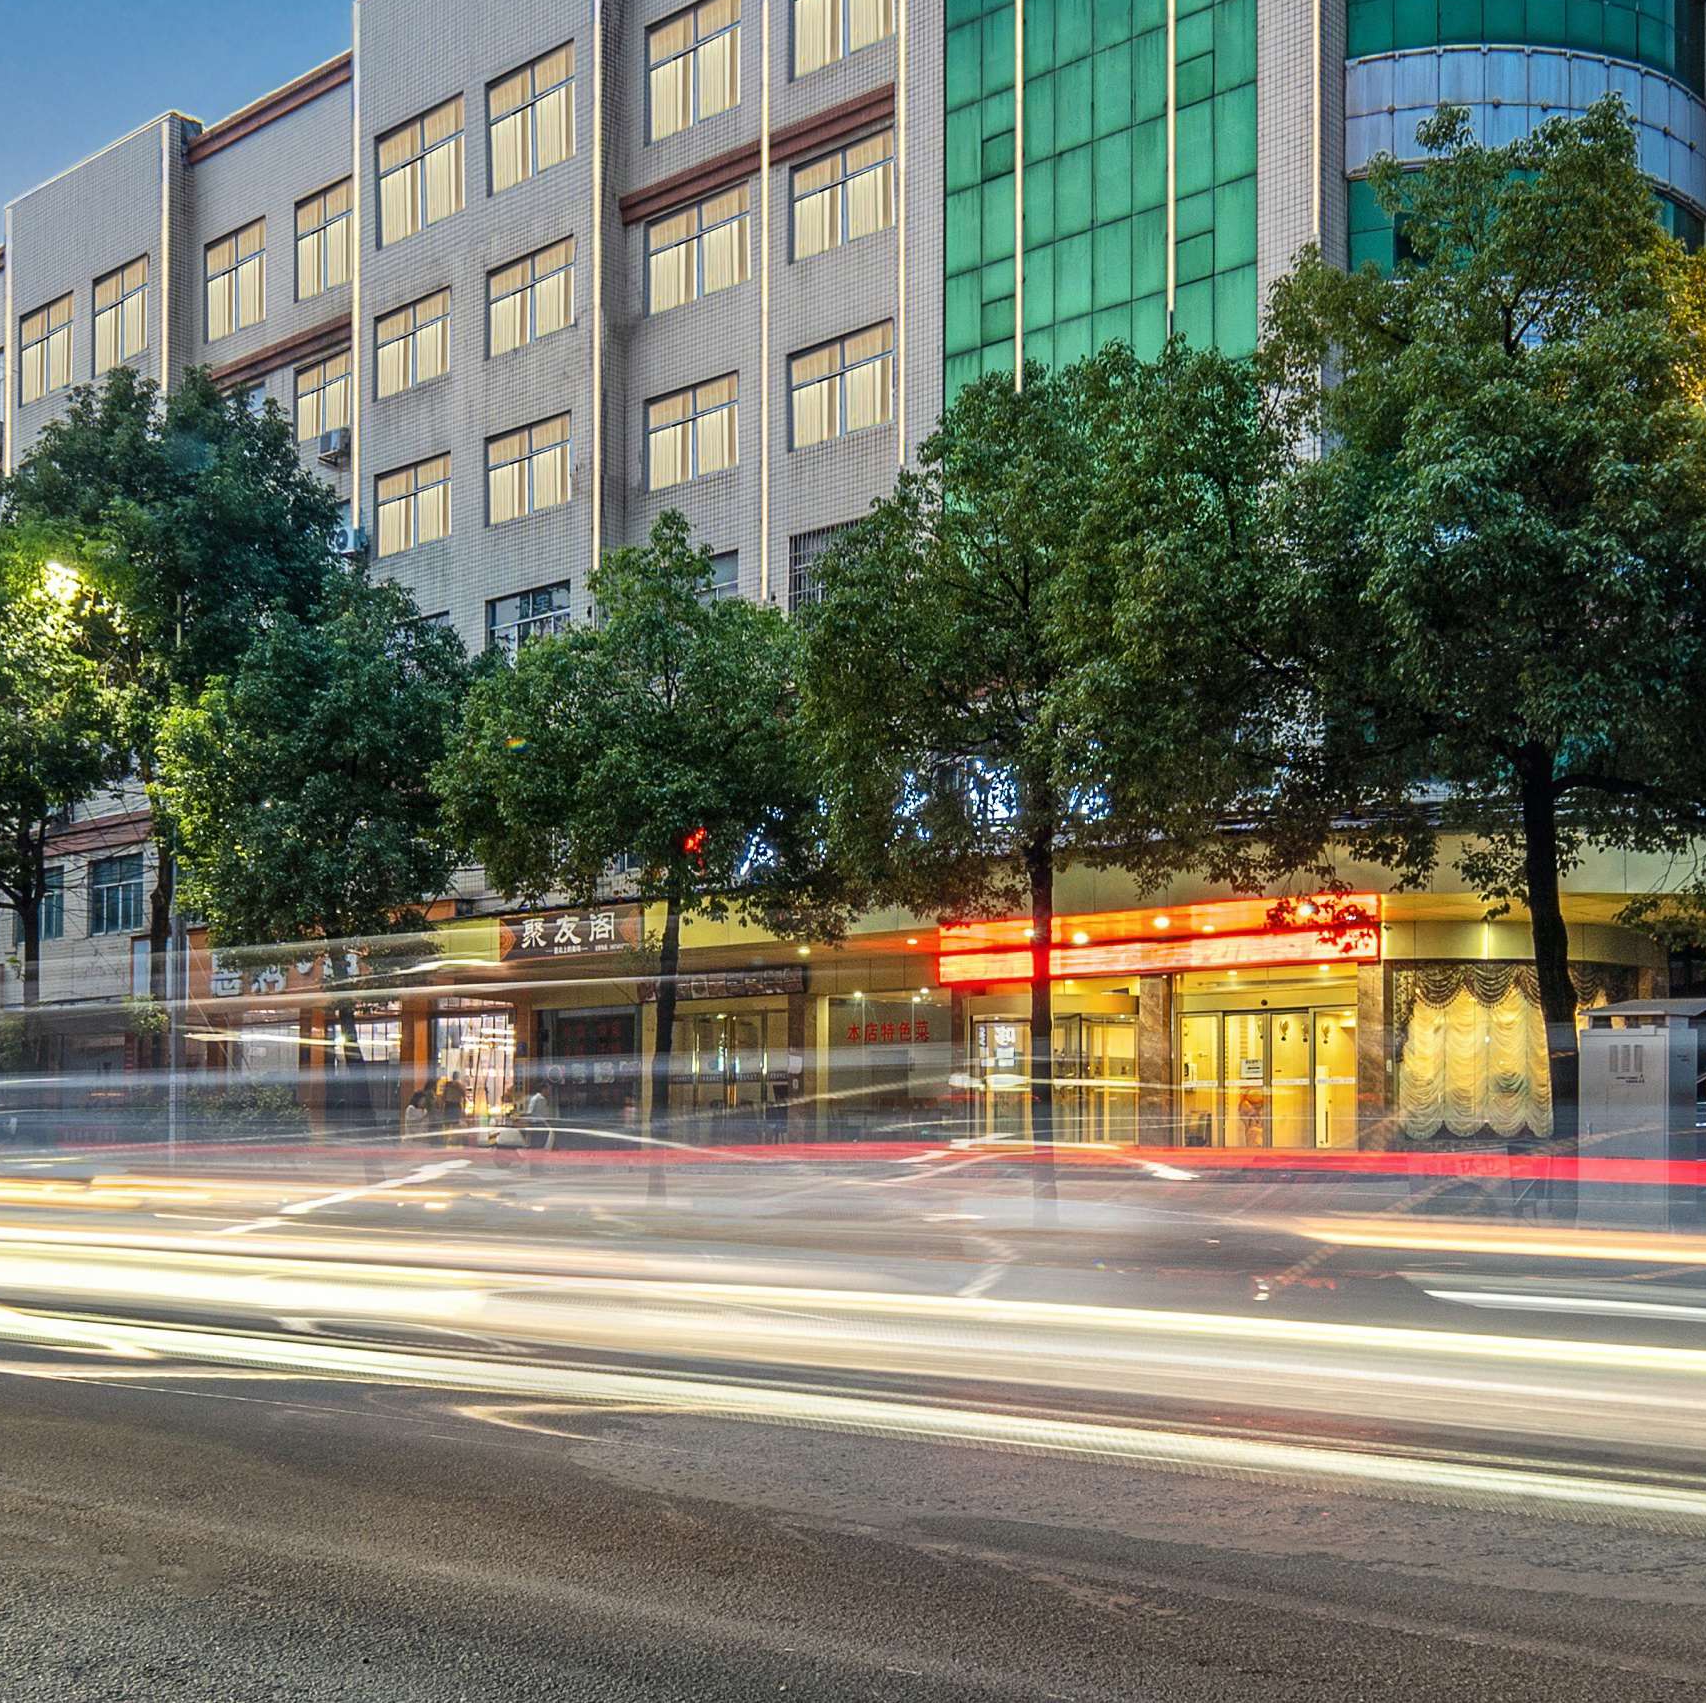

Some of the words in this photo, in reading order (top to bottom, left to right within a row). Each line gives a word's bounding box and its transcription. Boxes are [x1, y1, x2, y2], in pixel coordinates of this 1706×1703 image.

[521, 911, 616, 949] 聚友阁
[847, 1019, 931, 1044] 本店特色菜
